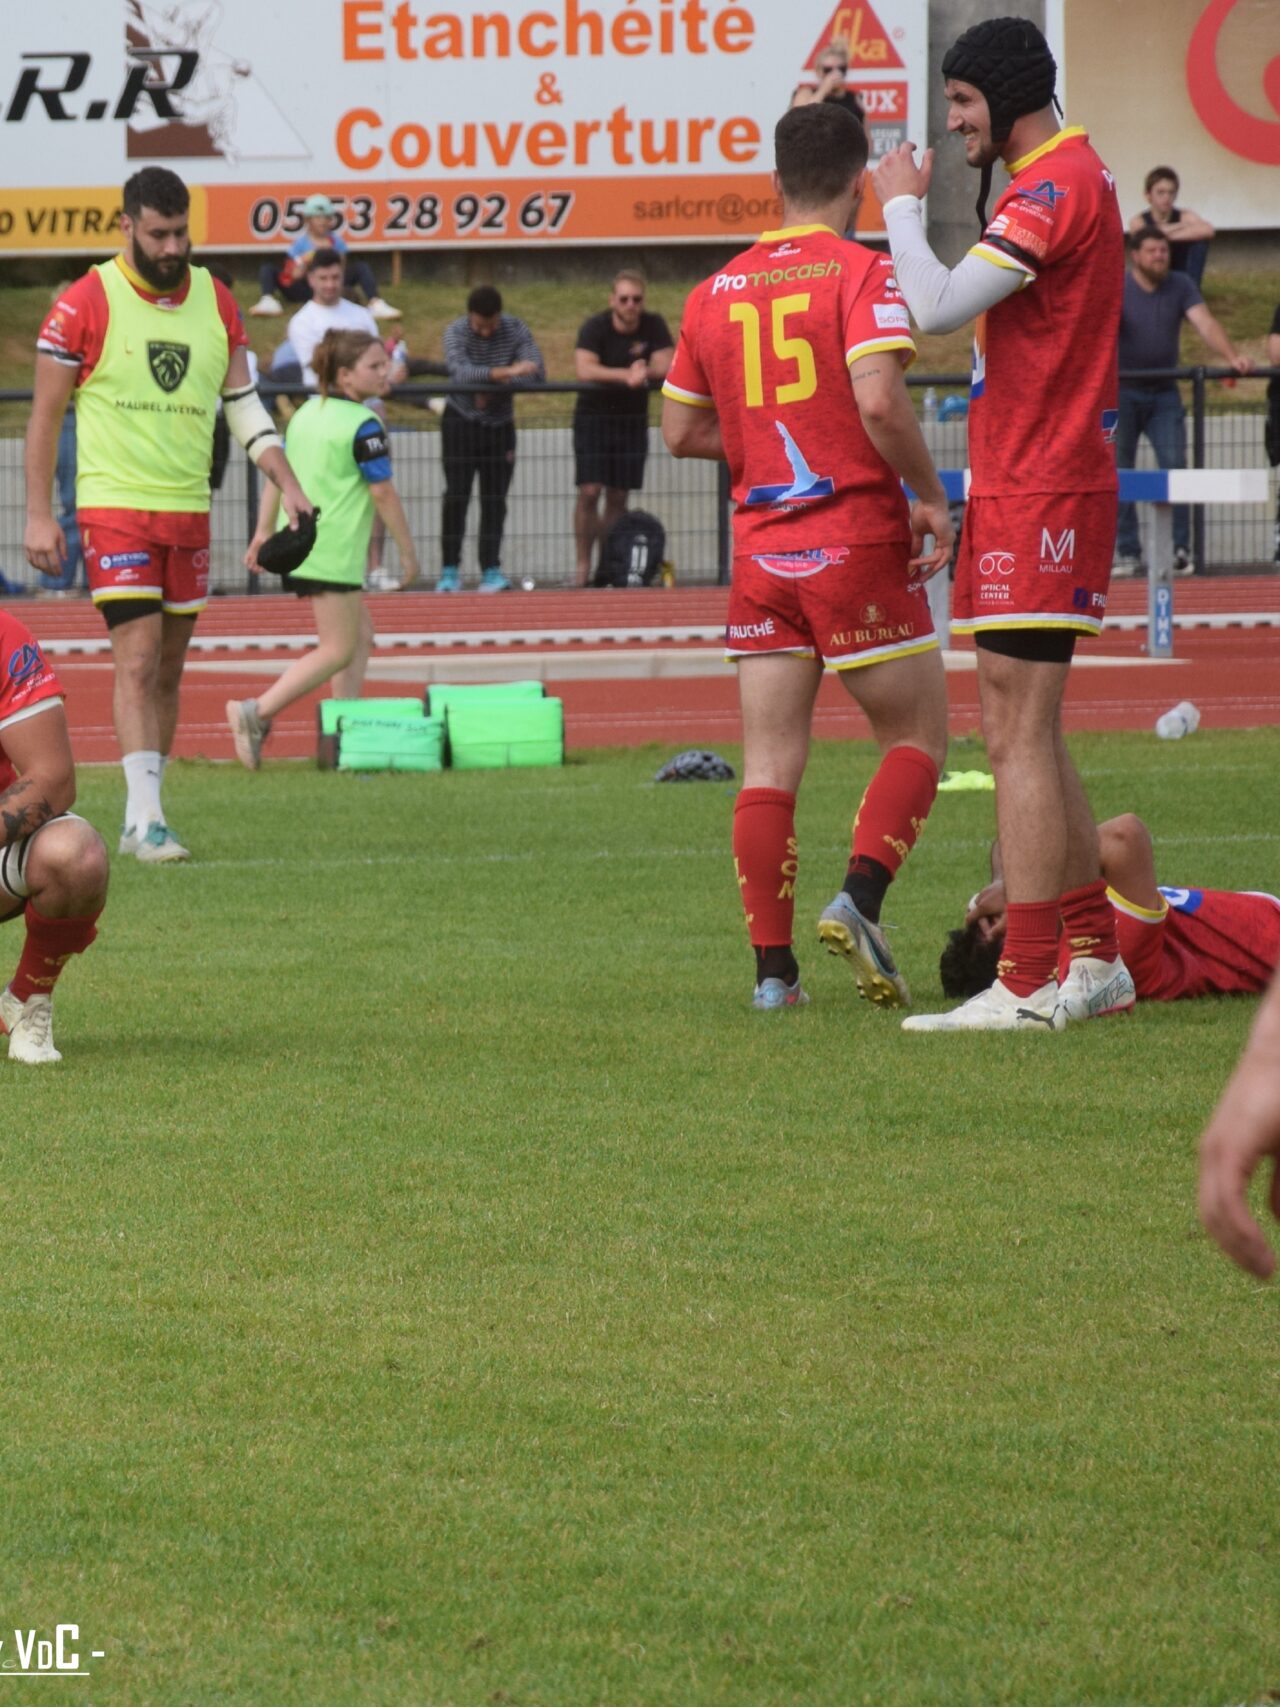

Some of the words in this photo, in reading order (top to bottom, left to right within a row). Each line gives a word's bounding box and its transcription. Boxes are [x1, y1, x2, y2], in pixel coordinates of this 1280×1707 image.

[534, 72, 563, 106] &
[335, 105, 761, 171] Couverture
[25, 207, 124, 234] VITRA
[383, 194, 439, 231] 28
[454, 193, 508, 230] 92
[519, 191, 574, 229] 67
[632, 193, 785, 226] sarlcrr@ora
[712, 258, 842, 295] Promocash
[729, 293, 818, 408] 15
[729, 618, 776, 640] FAUCHÉ
[829, 633, 852, 647] AU
[854, 622, 916, 643] BUREAU
